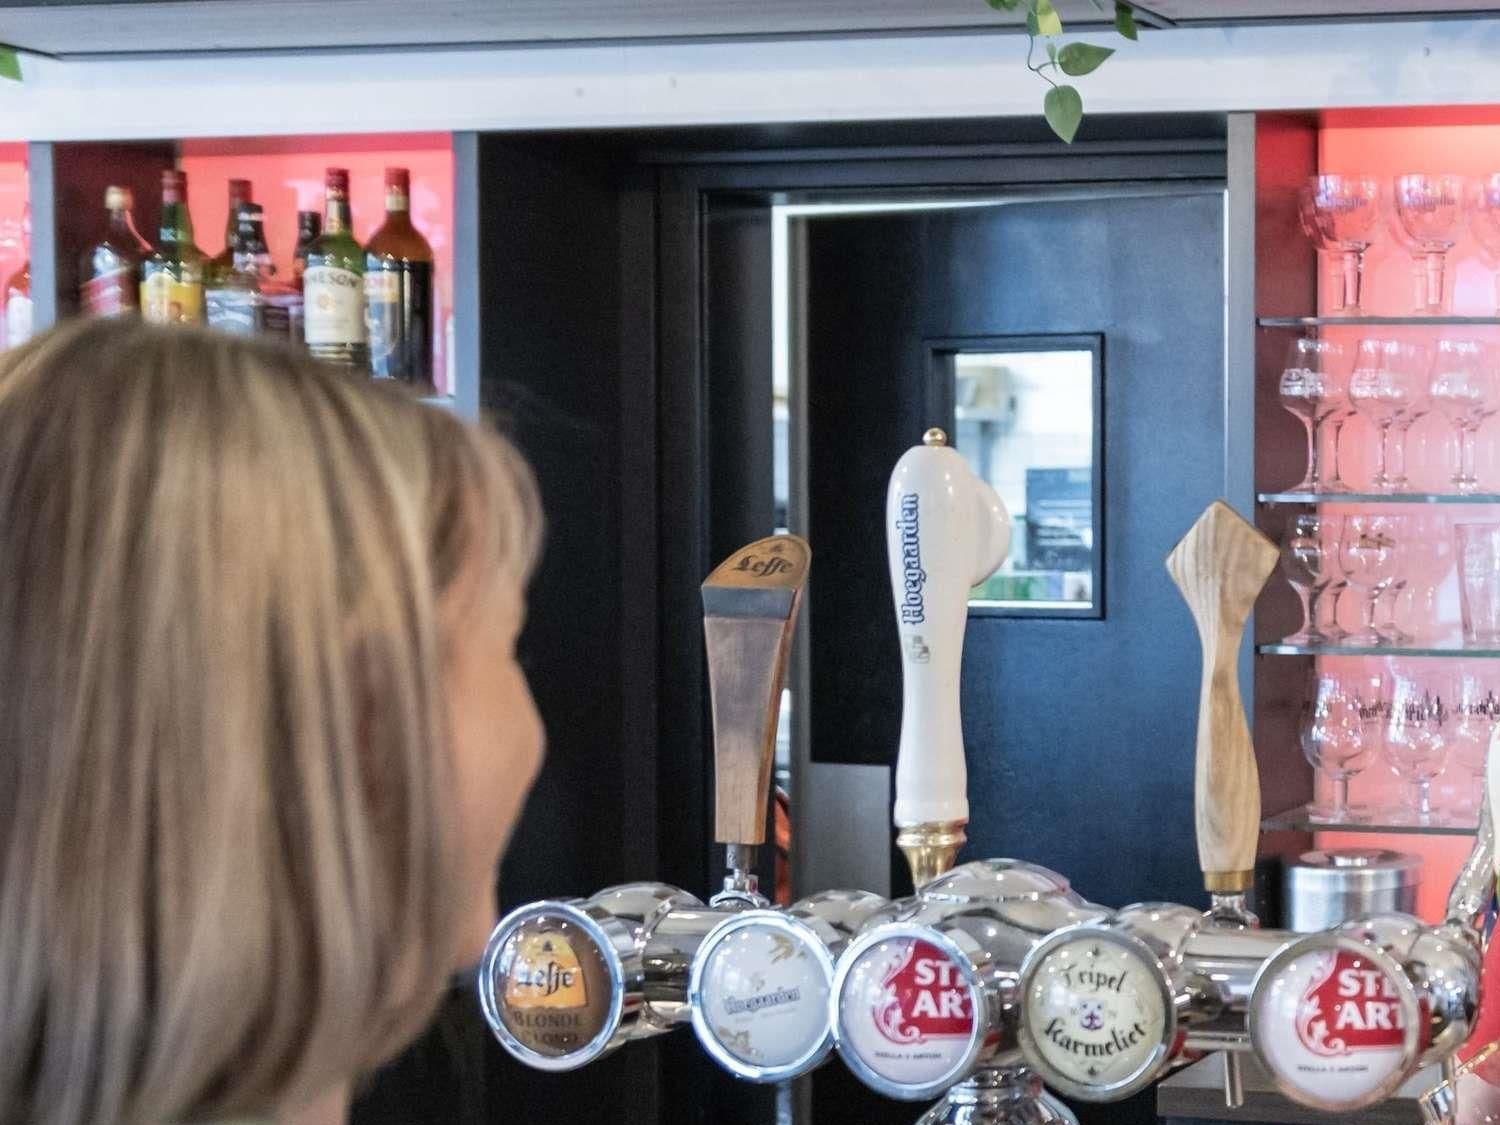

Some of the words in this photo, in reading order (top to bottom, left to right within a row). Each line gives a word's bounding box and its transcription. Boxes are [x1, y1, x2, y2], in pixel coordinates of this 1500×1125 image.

[731, 554, 795, 577] Leffe
[896, 492, 927, 625] Hoegaarden
[1060, 963, 1128, 993] Tripel
[911, 989, 973, 1019] AR
[1043, 1017, 1147, 1058] Karmeliet
